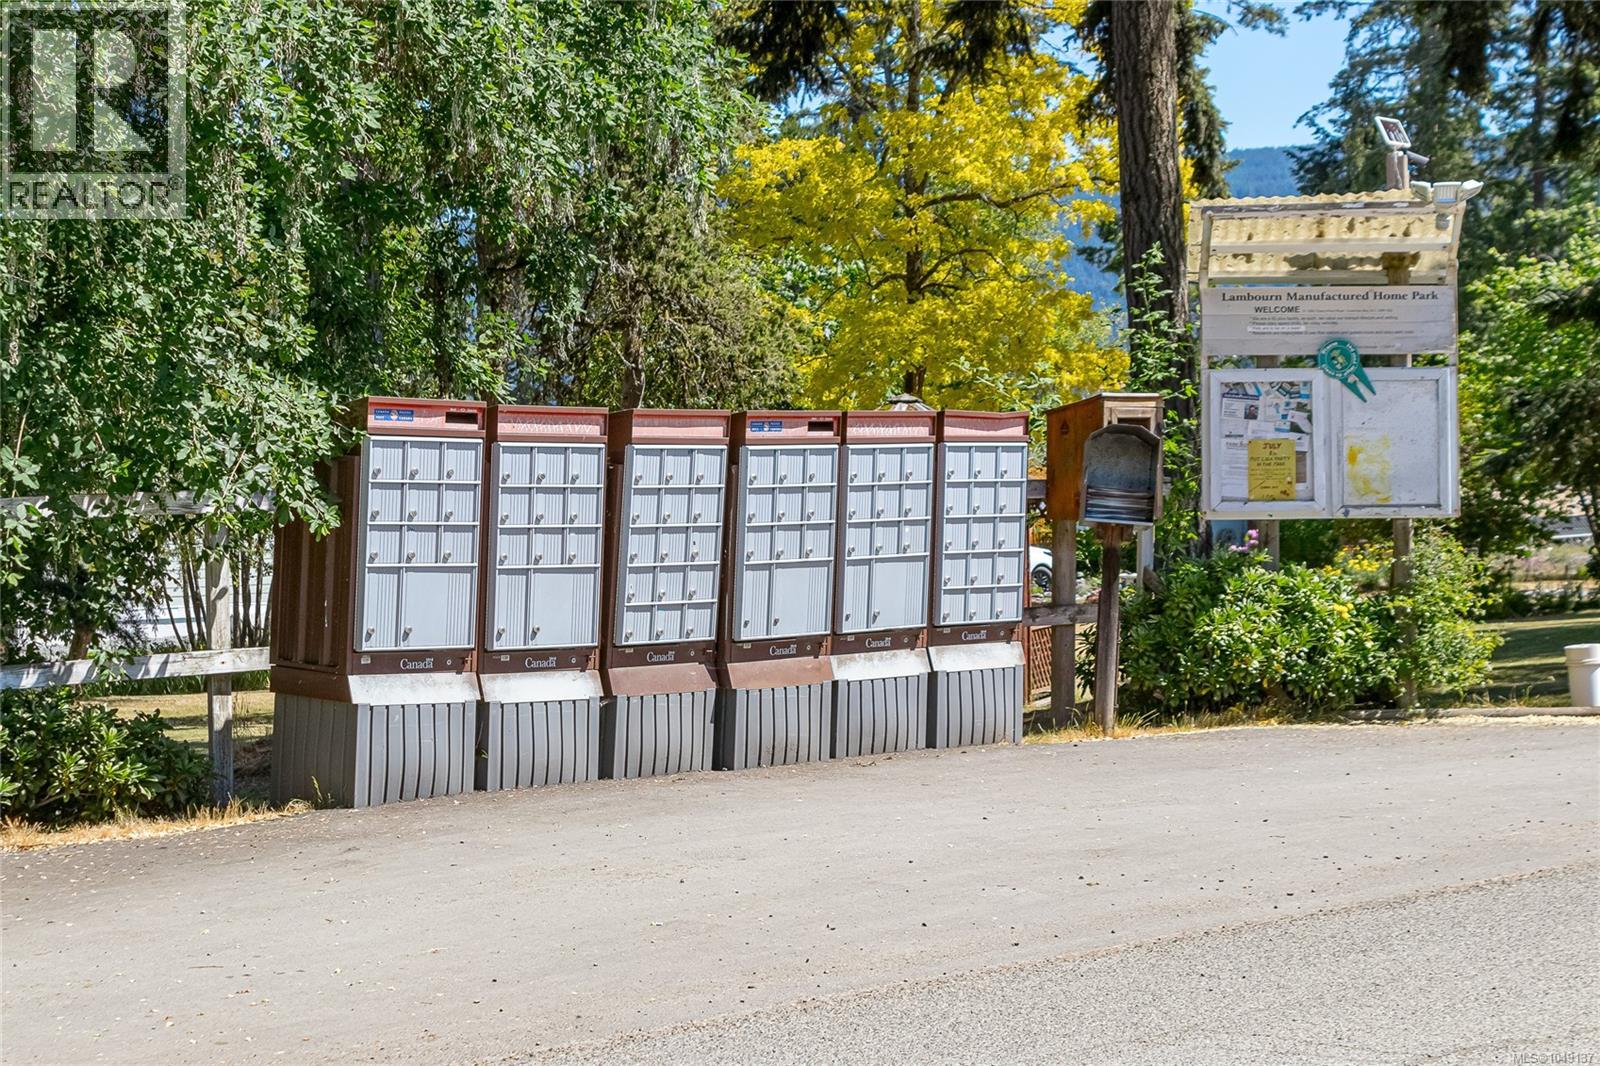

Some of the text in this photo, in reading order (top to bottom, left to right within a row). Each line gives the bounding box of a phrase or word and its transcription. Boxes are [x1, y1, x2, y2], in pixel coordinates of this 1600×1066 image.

[1221, 290, 1439, 301] Lambourn Manufactured Home Park
[1254, 305, 1301, 313] WELCOME
[961, 630, 987, 641] Canada
[865, 637, 891, 648] Canada
[769, 644, 797, 656] Canada
[646, 651, 675, 662] Canada
[400, 658, 434, 670] Canada
[525, 657, 557, 668] Canada
